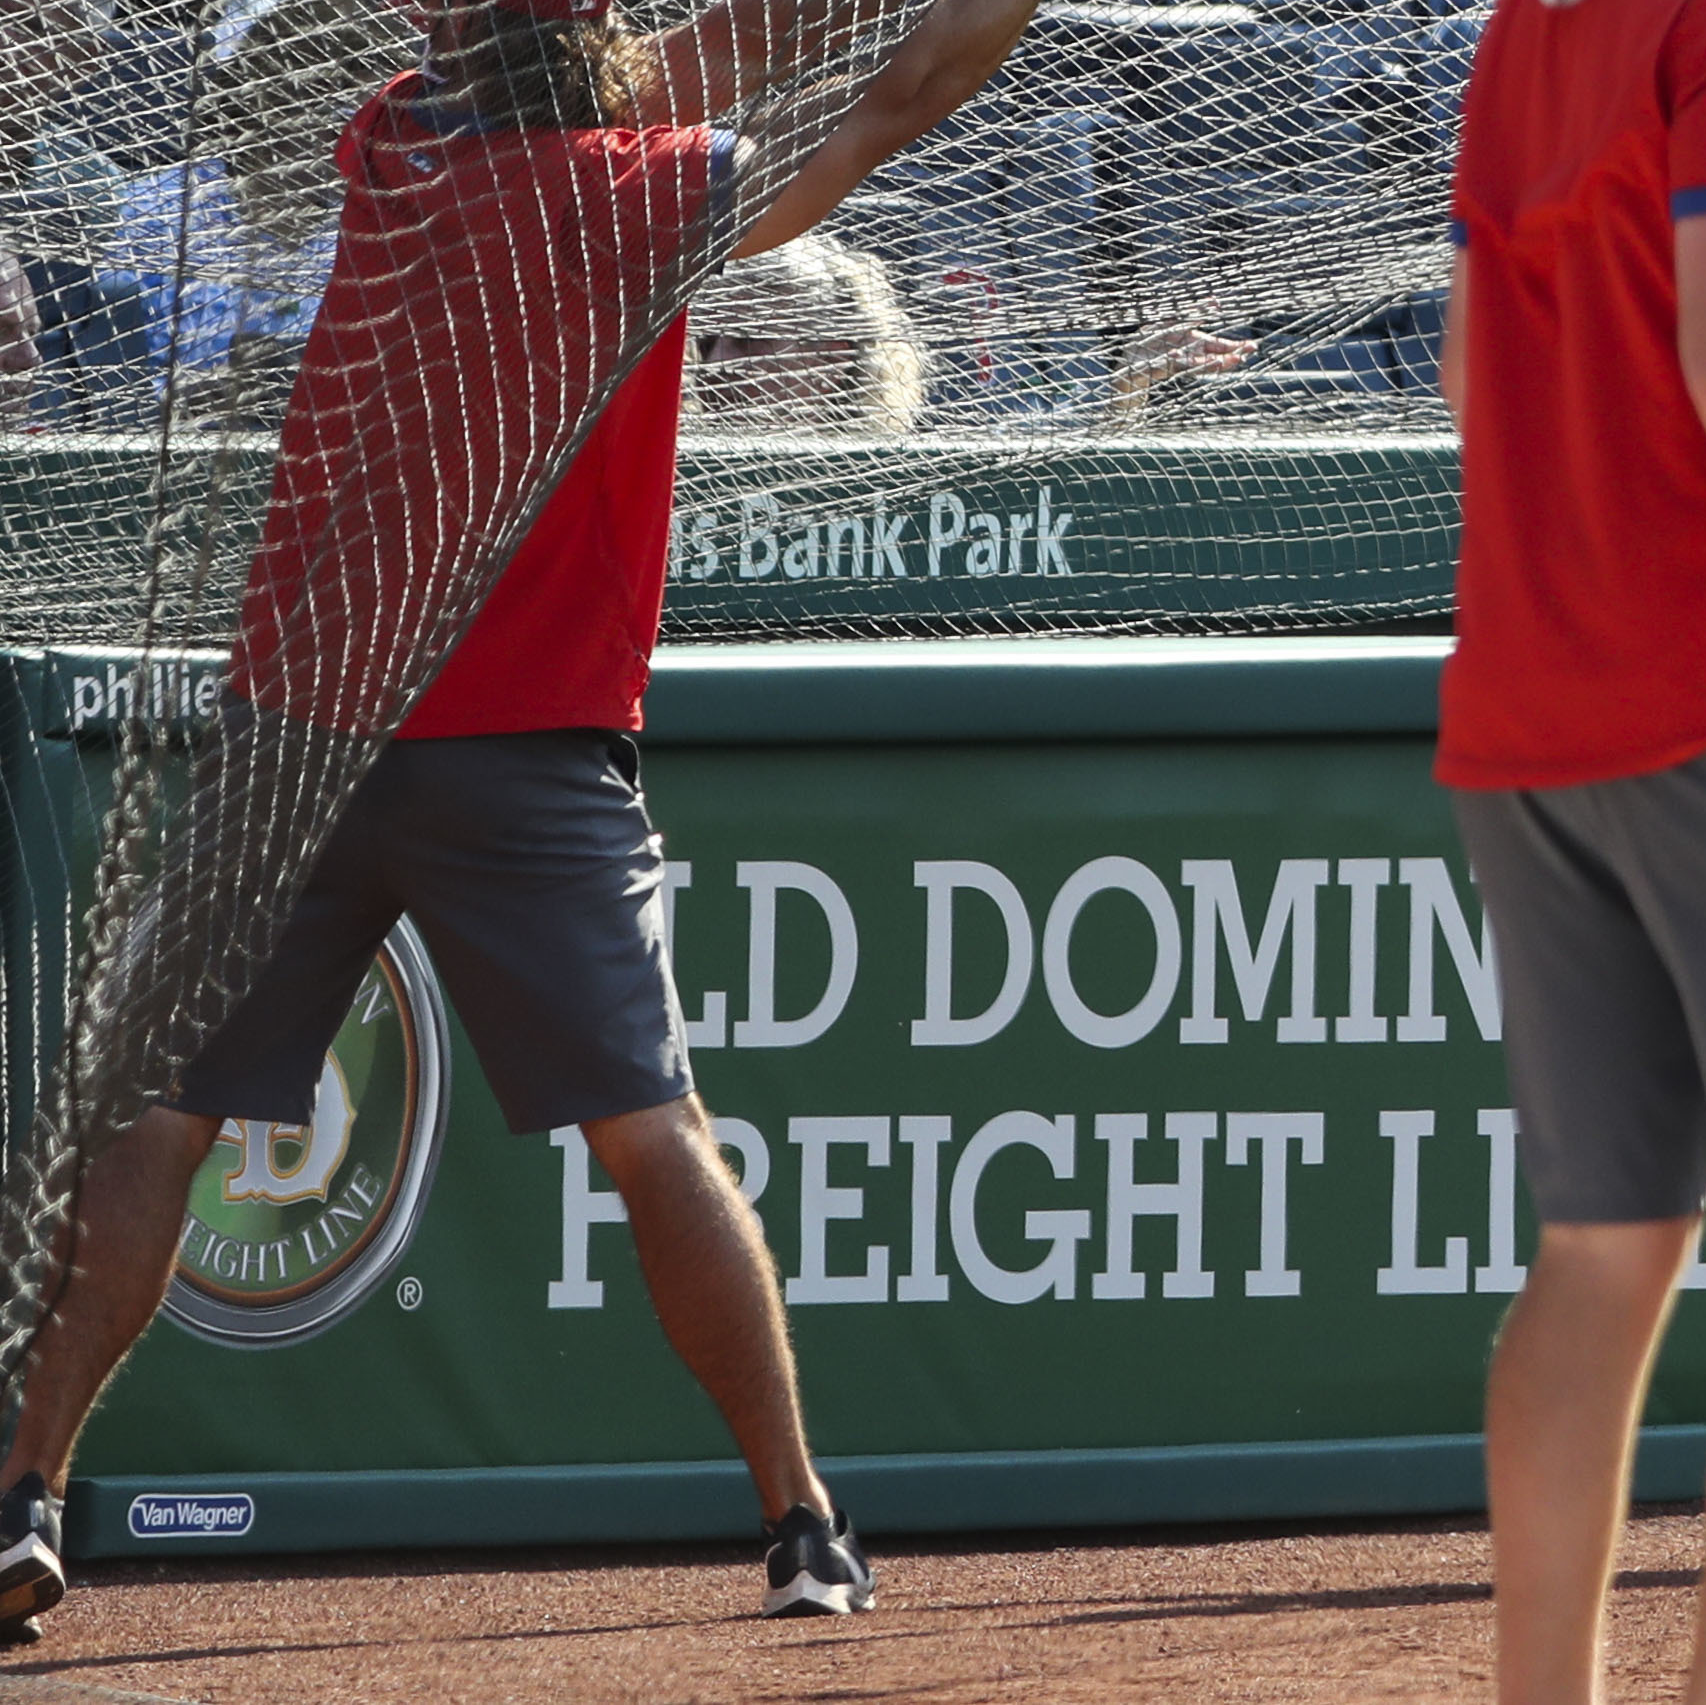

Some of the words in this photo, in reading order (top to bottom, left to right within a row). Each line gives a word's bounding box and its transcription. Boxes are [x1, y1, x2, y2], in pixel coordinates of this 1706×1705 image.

[739, 490, 908, 580] Bank
[929, 485, 1072, 577] Park
[300, 1165, 383, 1265] LINE
[135, 1502, 175, 1527] Van
[177, 1501, 248, 1531] Wagner
